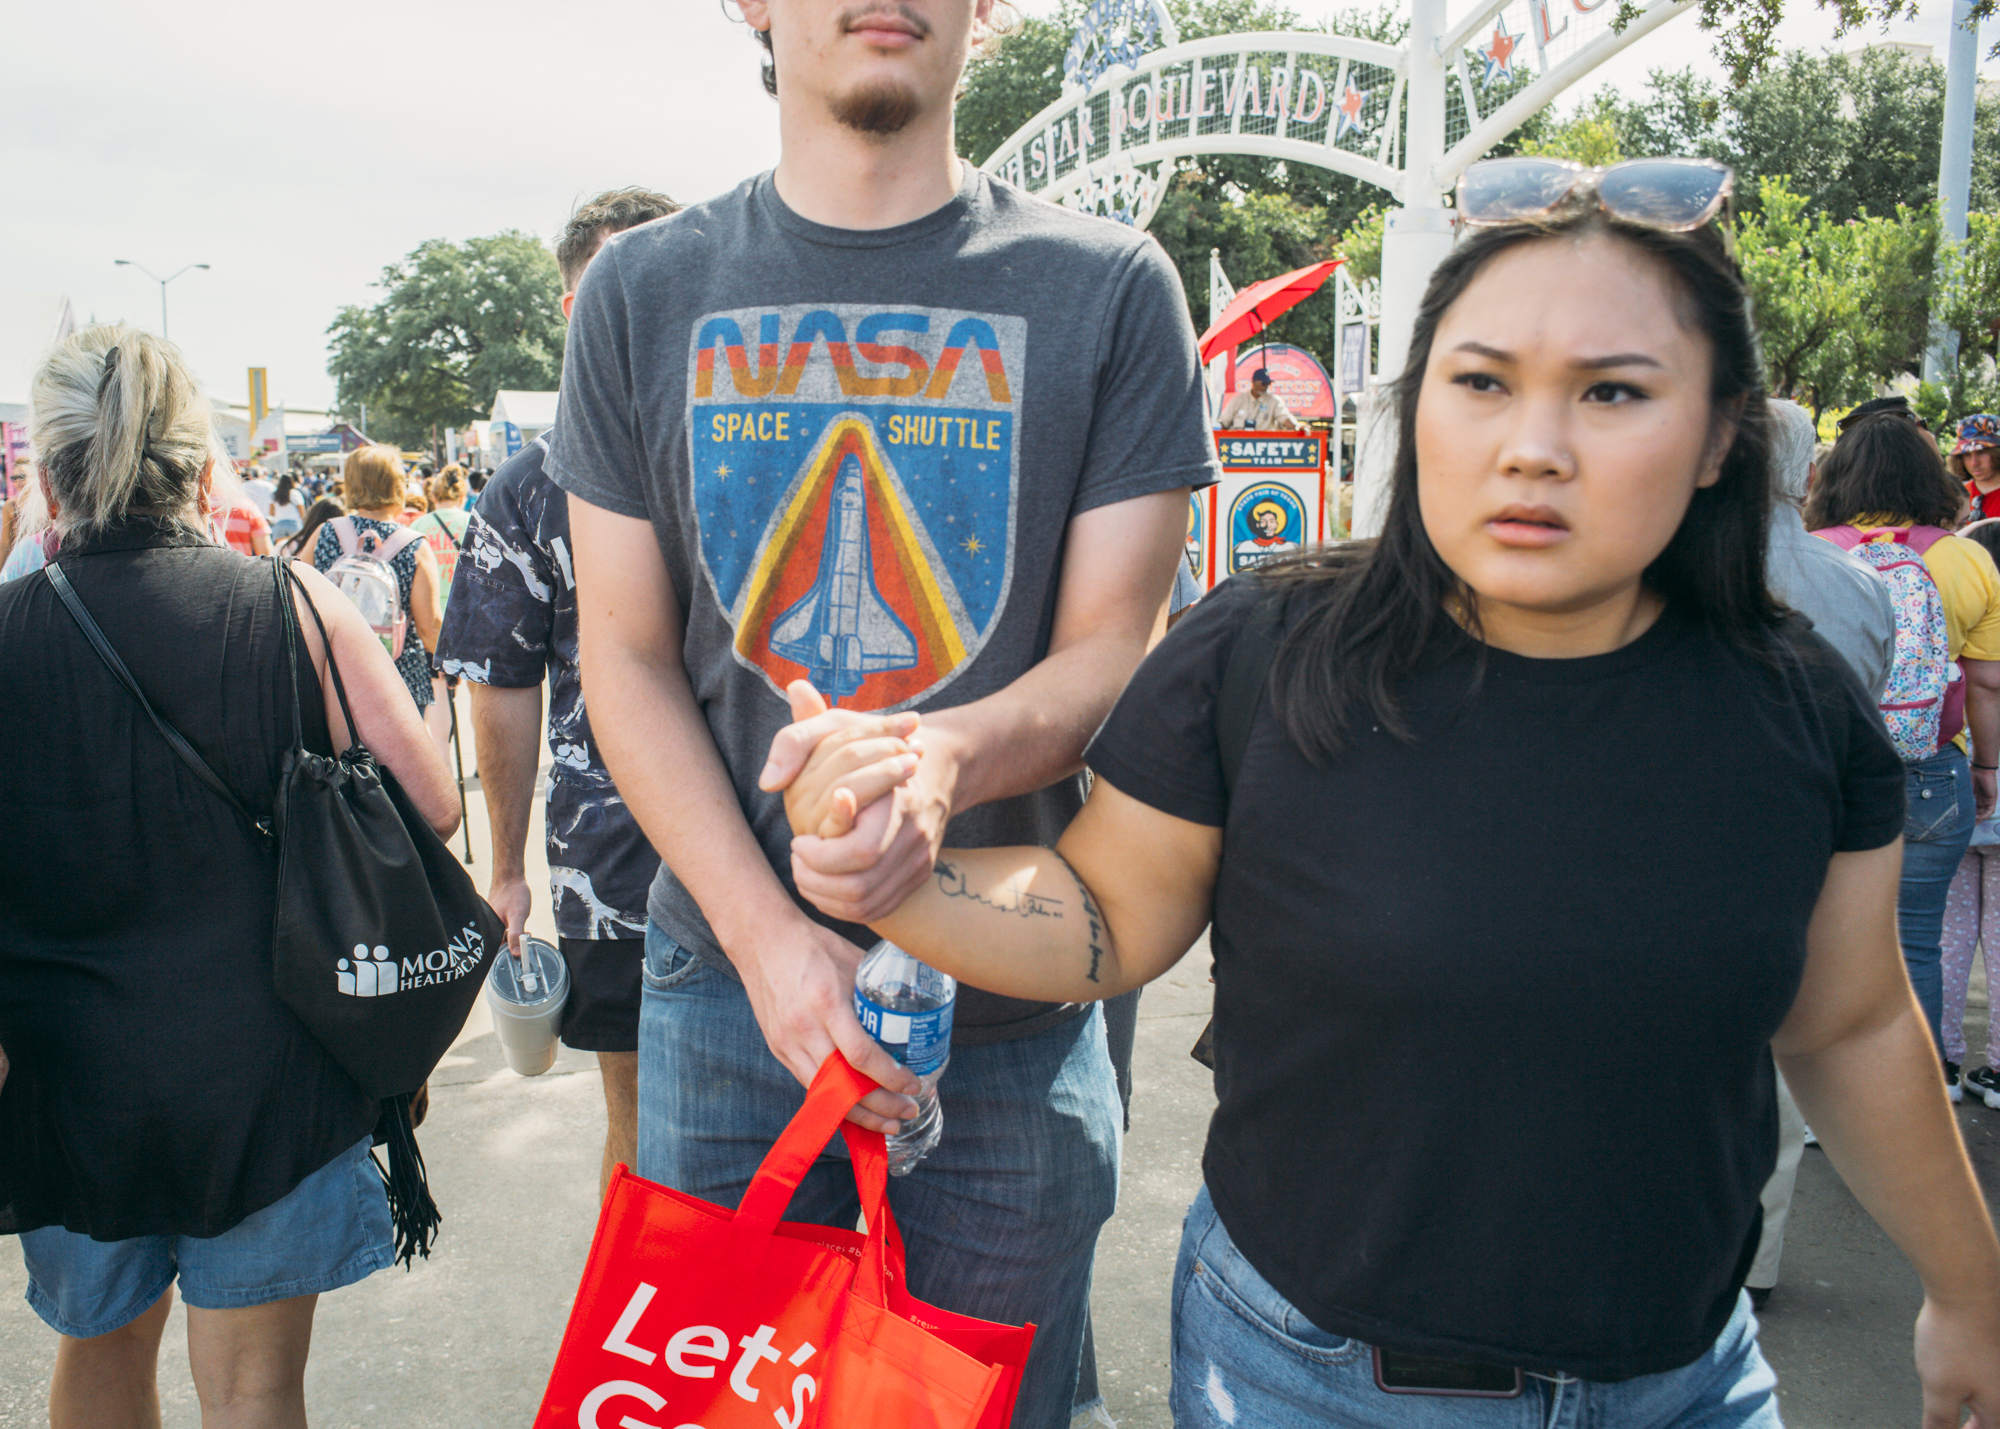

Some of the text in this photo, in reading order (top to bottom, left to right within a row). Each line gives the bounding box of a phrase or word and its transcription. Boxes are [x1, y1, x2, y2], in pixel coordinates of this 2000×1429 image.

[1030, 107, 1095, 178] STAR
[1109, 66, 1326, 136] BOULEVARD
[694, 310, 1013, 403] NASA
[711, 412, 1001, 450] SPACE SHUTTLE
[1230, 442, 1305, 456] SAFETY
[1253, 457, 1282, 465] TEAM
[400, 926, 483, 978] MONA
[601, 1281, 817, 1429] Let's
